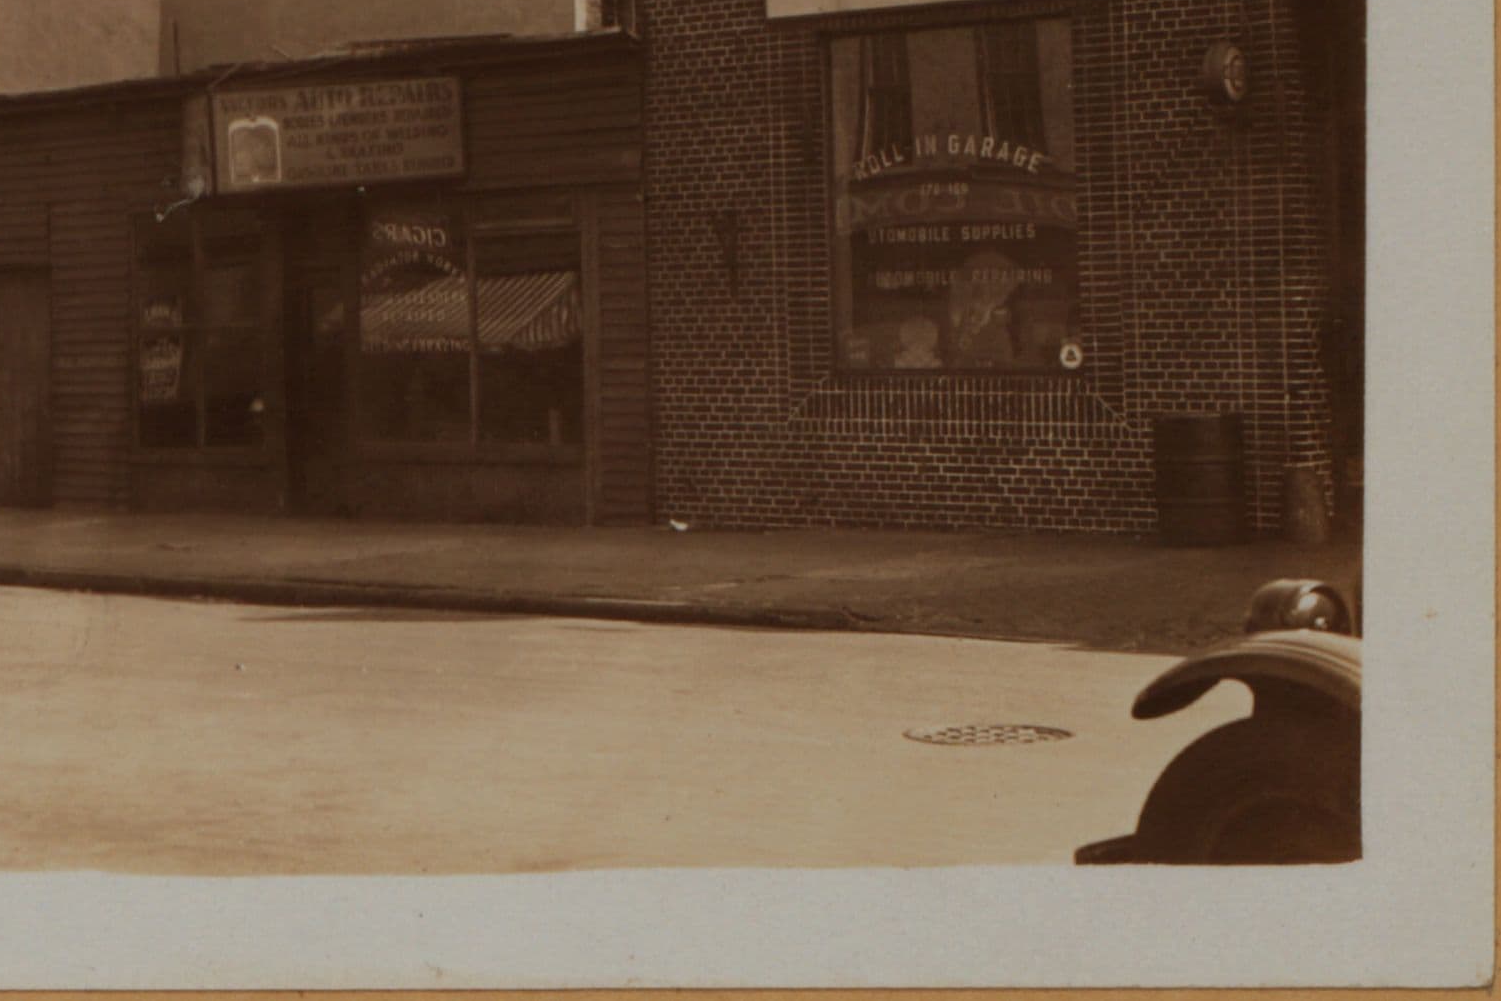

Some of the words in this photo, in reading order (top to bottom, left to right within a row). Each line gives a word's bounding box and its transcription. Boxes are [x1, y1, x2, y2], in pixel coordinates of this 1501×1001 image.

[915, 135, 936, 157] IN
[948, 135, 1044, 174] GARAGE
[961, 222, 1036, 242] SUPPLIES
